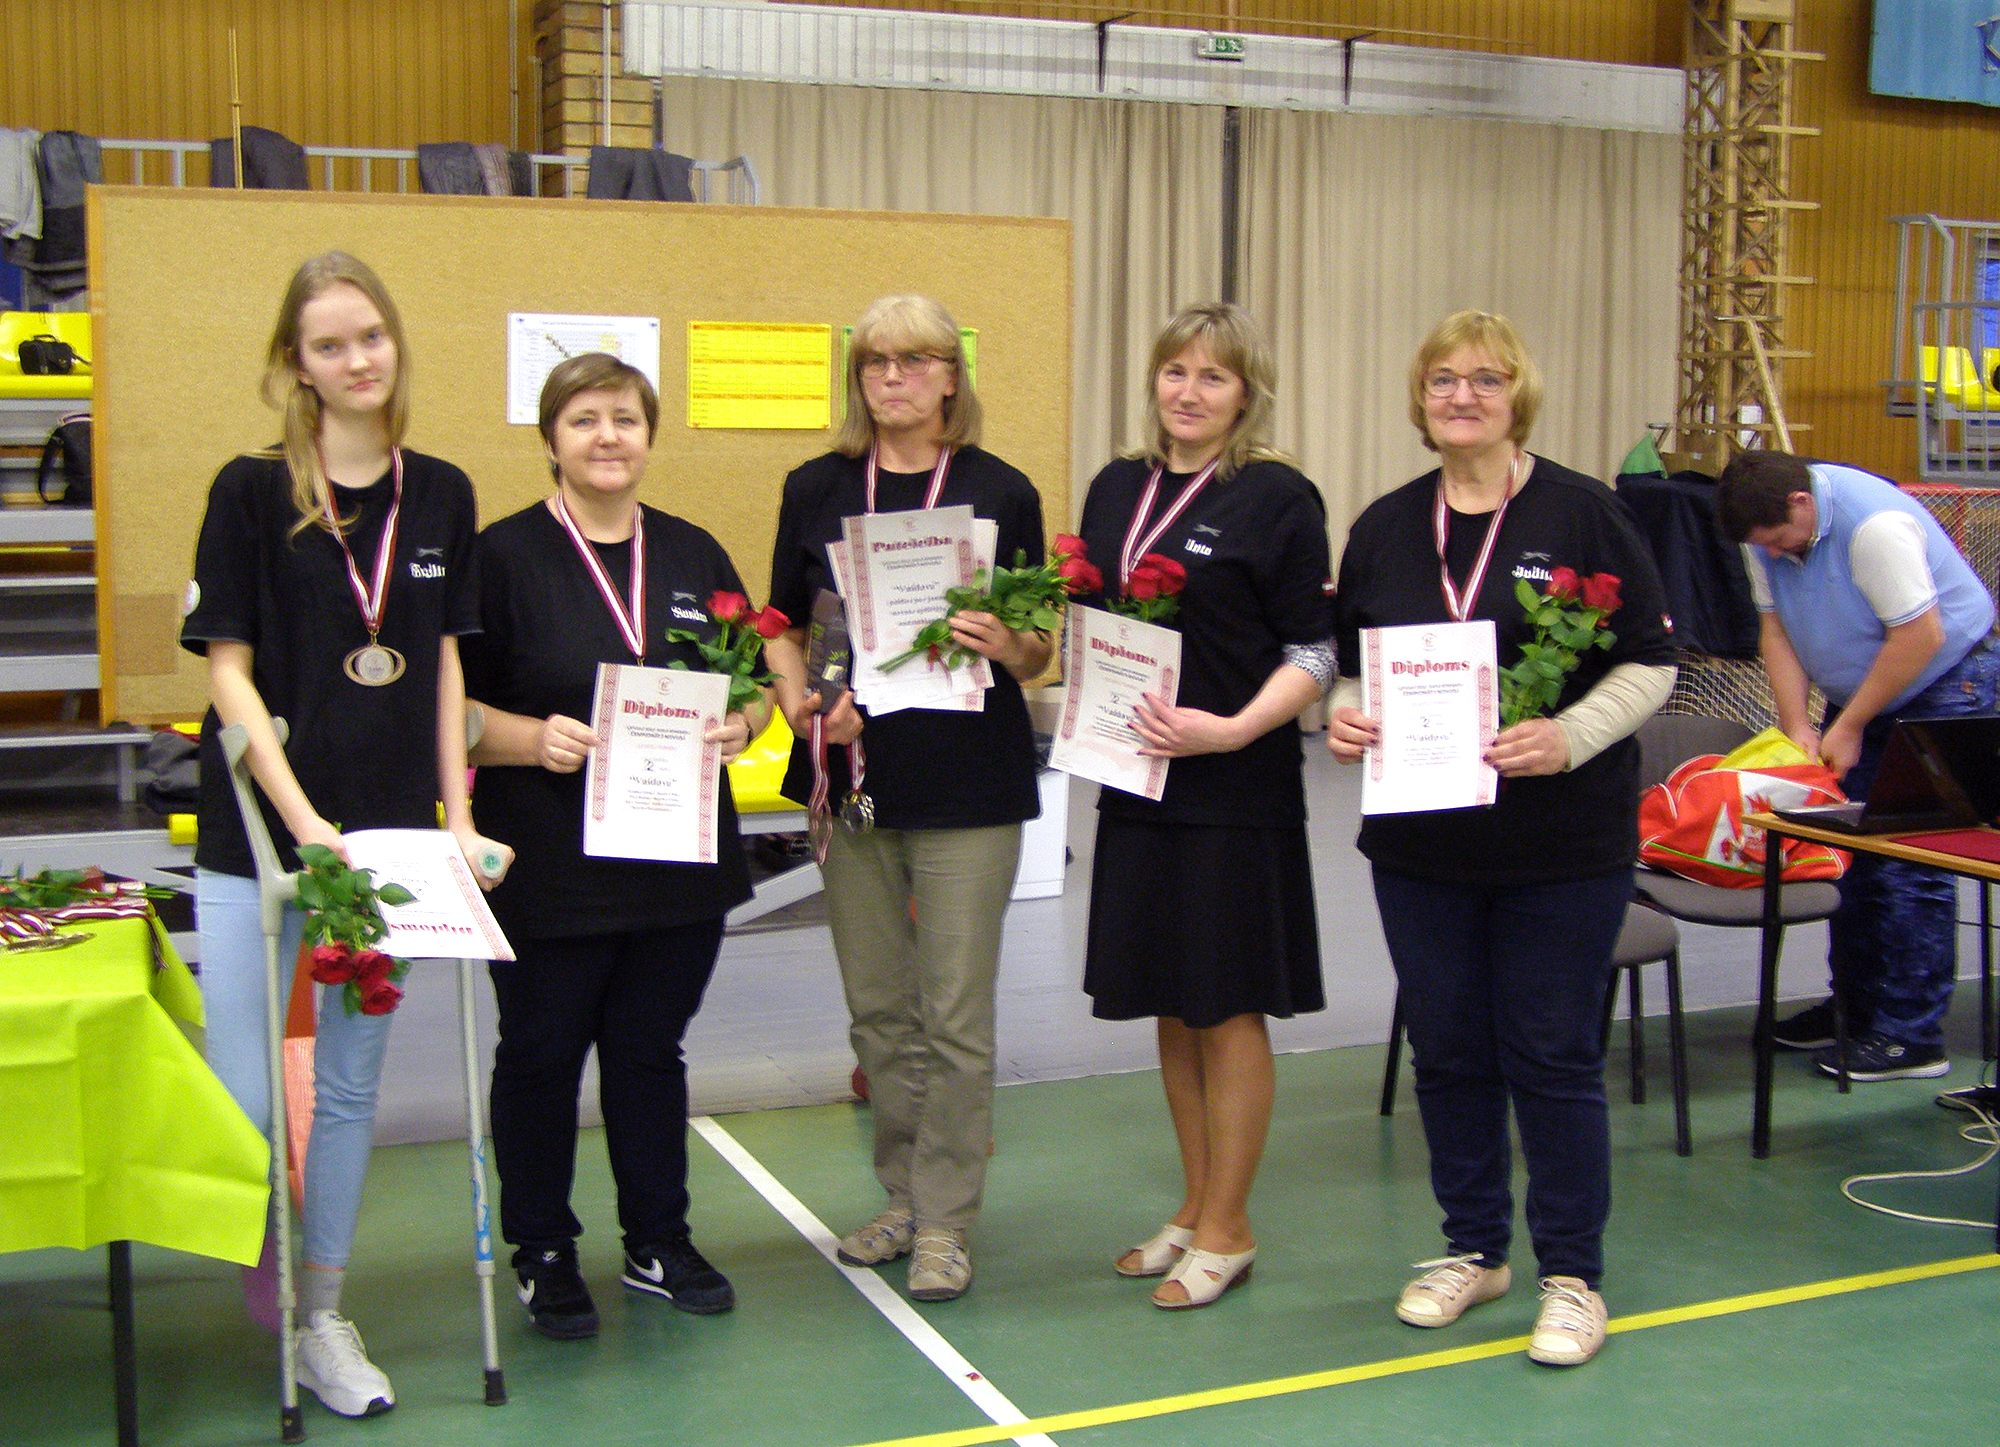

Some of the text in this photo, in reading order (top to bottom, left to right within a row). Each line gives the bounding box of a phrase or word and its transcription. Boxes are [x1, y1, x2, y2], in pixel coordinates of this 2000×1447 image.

[1090, 636, 1158, 667] Diploms
[1389, 659, 1471, 677] Diploms
[622, 698, 700, 720] Diploms
[643, 757, 655, 772] 2
